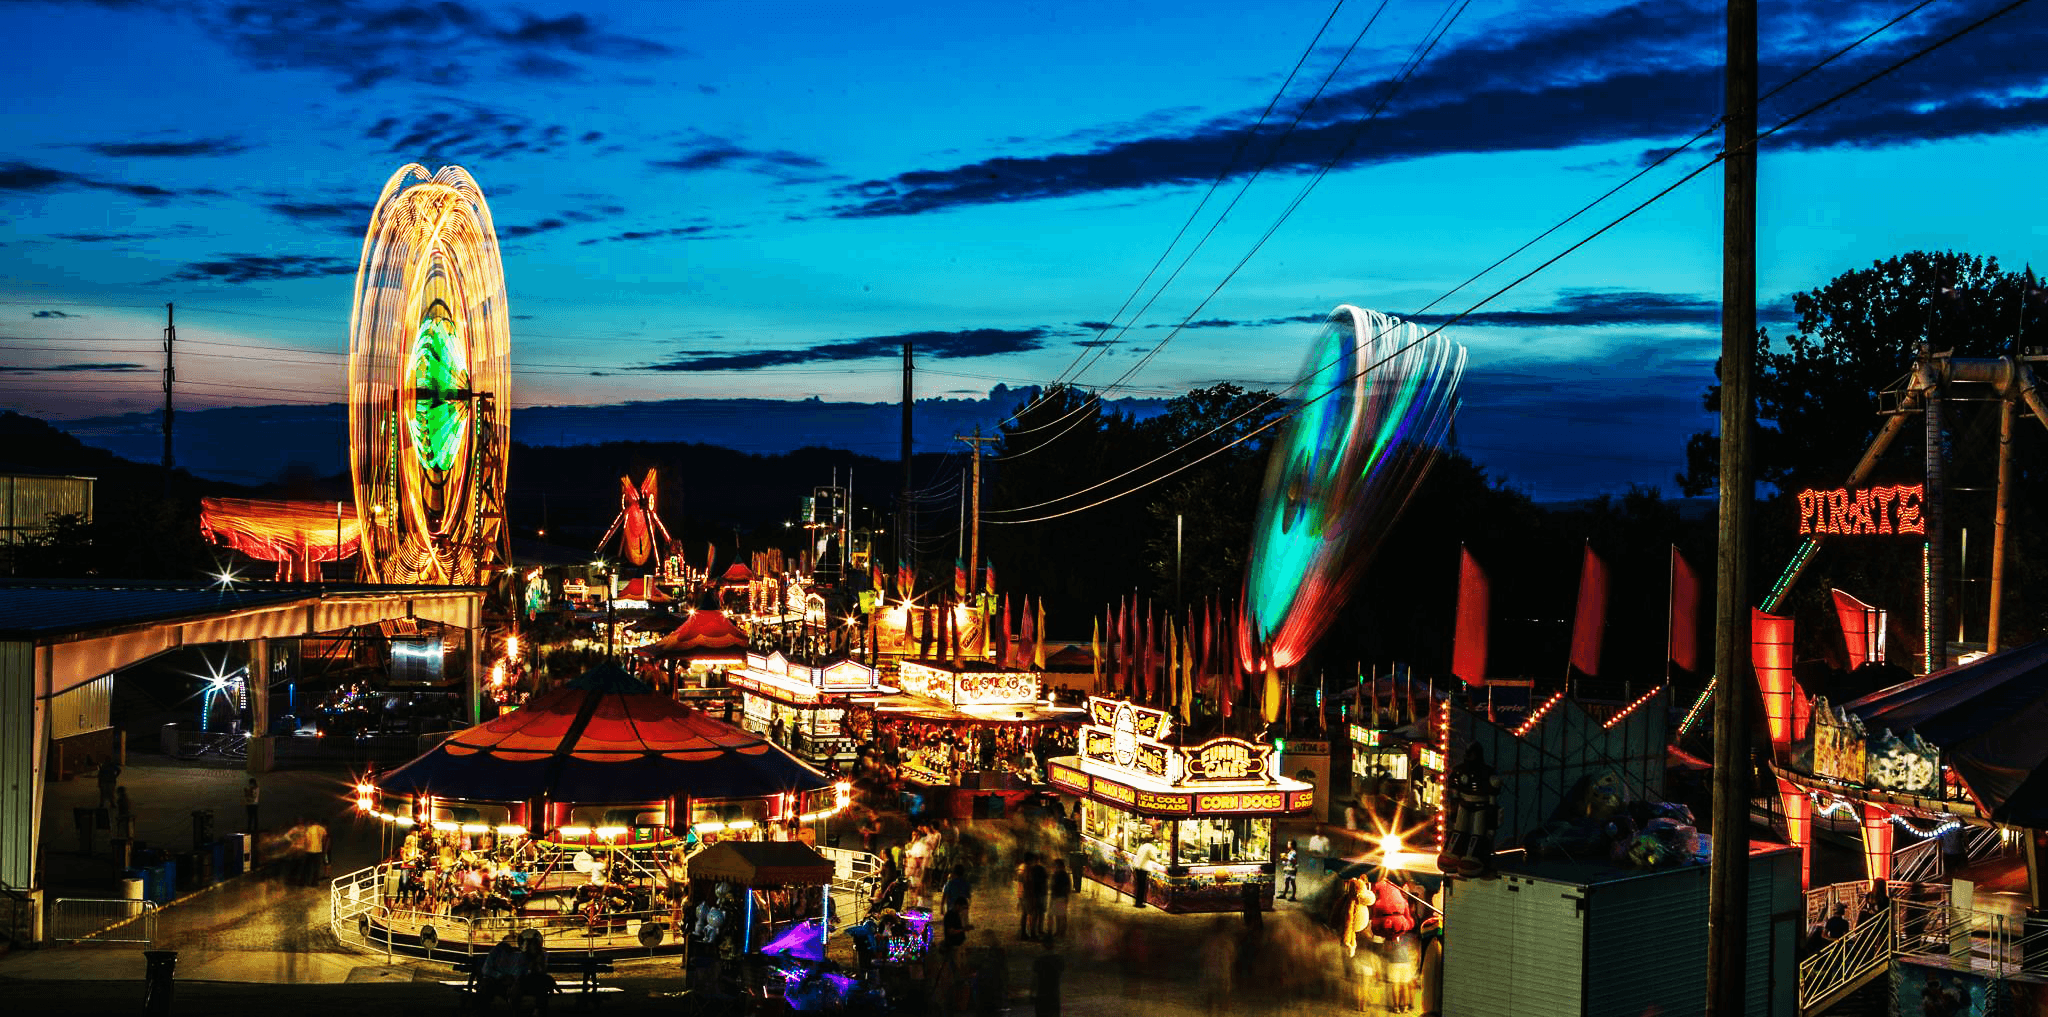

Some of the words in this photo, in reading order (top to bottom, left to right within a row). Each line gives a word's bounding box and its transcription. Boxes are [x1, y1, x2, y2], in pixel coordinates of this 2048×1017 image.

[1797, 485, 1925, 535] PIRATE
[1201, 745, 1250, 768] FUNNEL
[1204, 761, 1248, 778] CAKES
[1138, 801, 1189, 811] LEMONADE
[1140, 794, 1154, 802] ICE
[1156, 796, 1186, 804] COLD
[1200, 796, 1240, 810] CORN
[1241, 795, 1281, 809] DOGS
